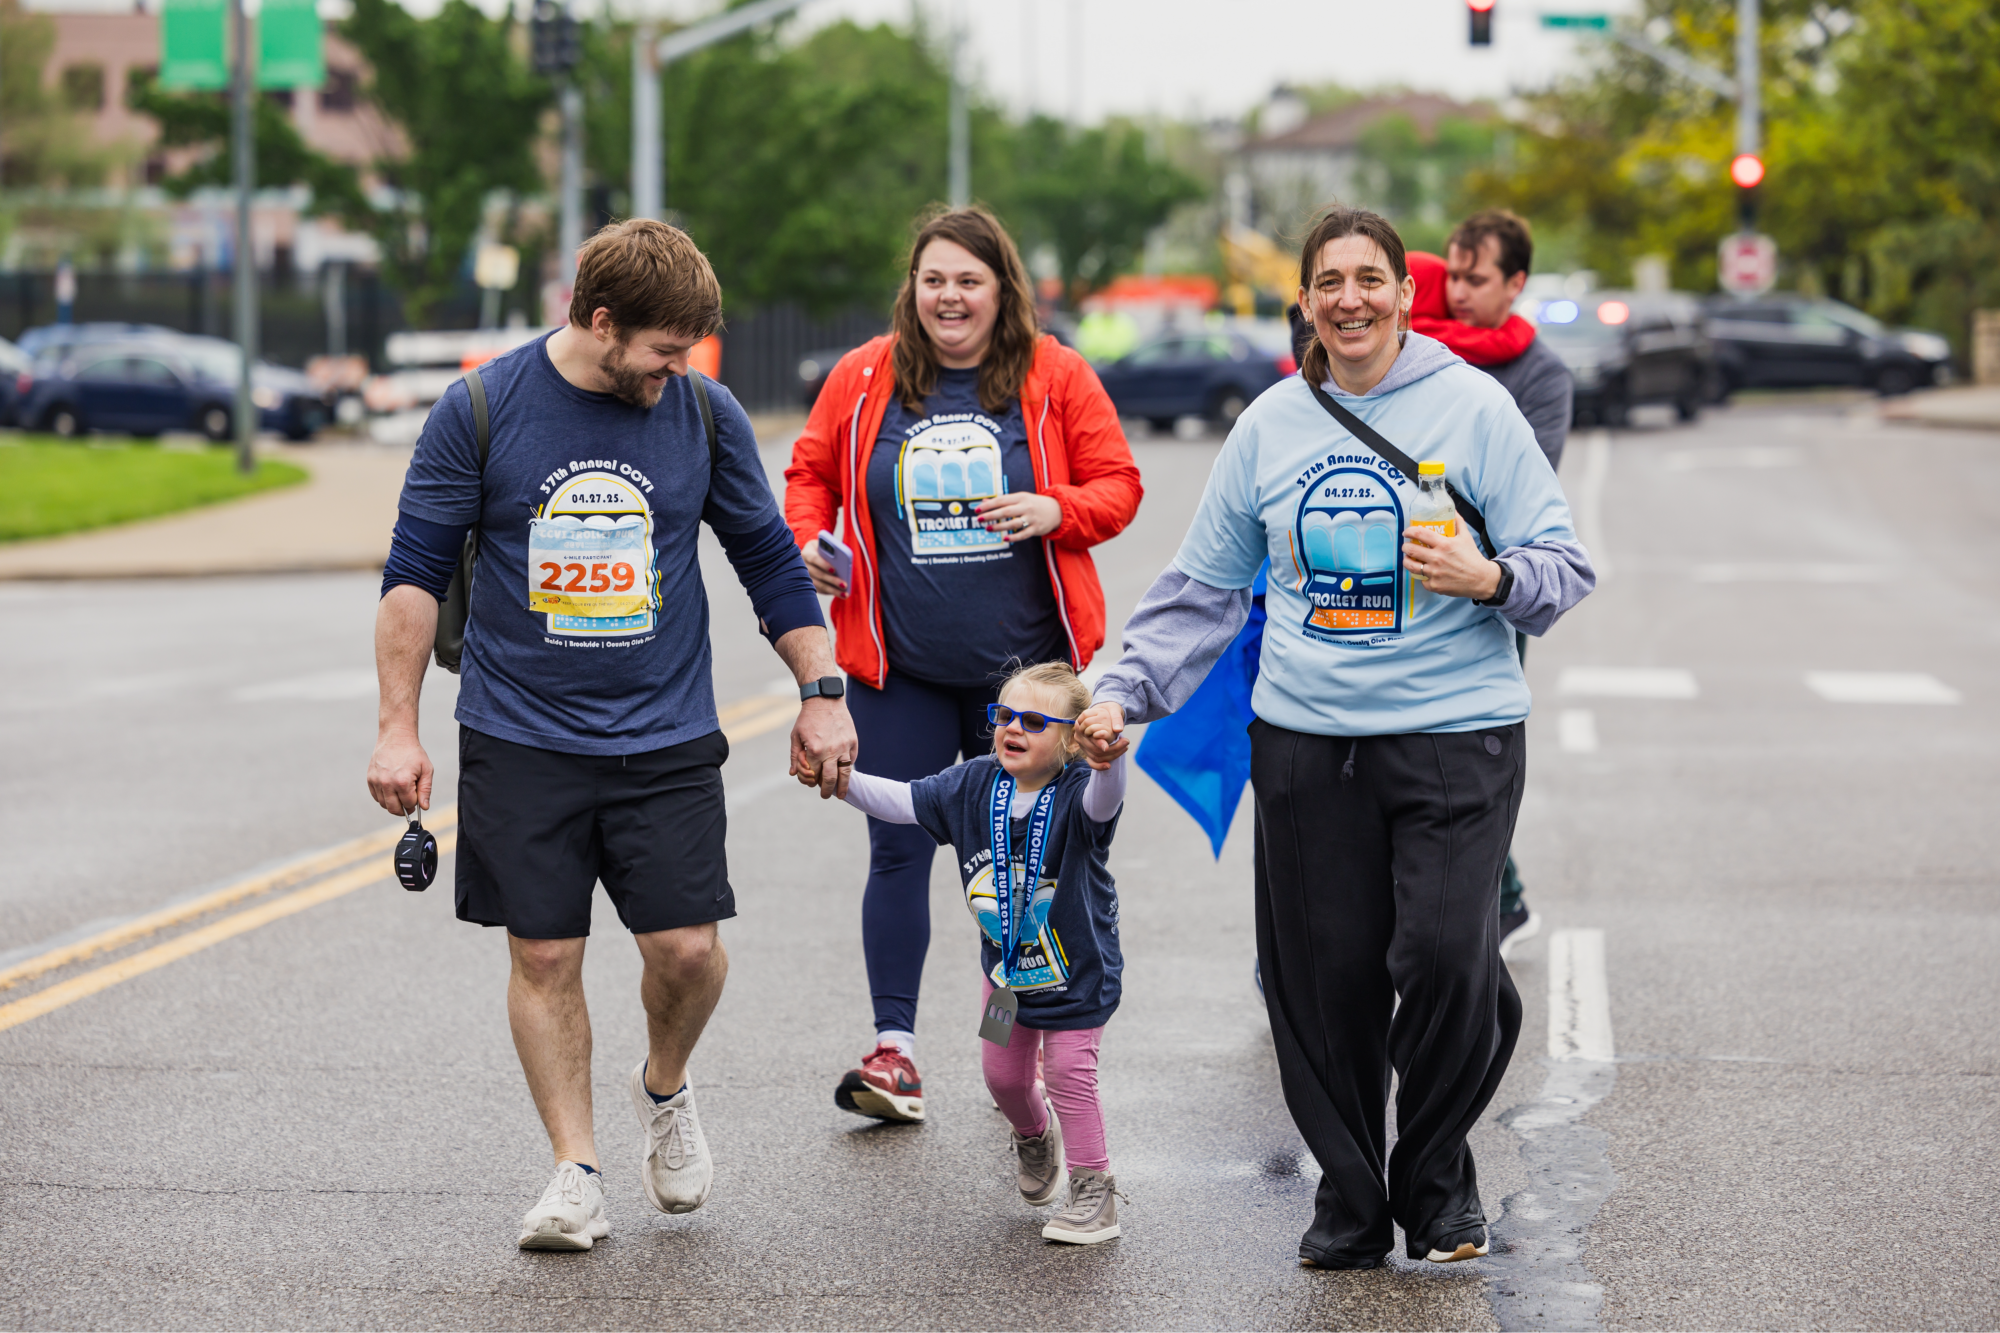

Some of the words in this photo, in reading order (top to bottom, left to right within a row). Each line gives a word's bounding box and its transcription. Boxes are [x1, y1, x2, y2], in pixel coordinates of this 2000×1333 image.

[904, 419, 932, 437] 37th
[540, 467, 568, 494] 37th
[569, 460, 618, 473] Annual
[620, 463, 655, 494] CCVI
[1296, 462, 1324, 488] 37th
[1327, 454, 1376, 466] Annual
[1378, 460, 1406, 487] CCVI
[571, 493, 624, 504] 04.27.25.
[1324, 487, 1375, 498] 04.27.25.
[918, 516, 969, 531] TROLLEY
[538, 561, 635, 593] 2259
[1308, 592, 1358, 607] TROLLEY
[1362, 595, 1392, 608] RUN
[543, 636, 563, 646] Waldo
[568, 640, 600, 648] Brookside
[605, 640, 630, 648] Country
[630, 638, 644, 646] Club
[994, 780, 1011, 811] CCVI
[1035, 785, 1056, 817] CCVI
[994, 813, 1007, 867] TROLLEY
[1028, 820, 1045, 873] TROLLEY
[997, 871, 1008, 898] RUN
[1025, 875, 1035, 902] RUN
[1000, 901, 1009, 935] 2025
